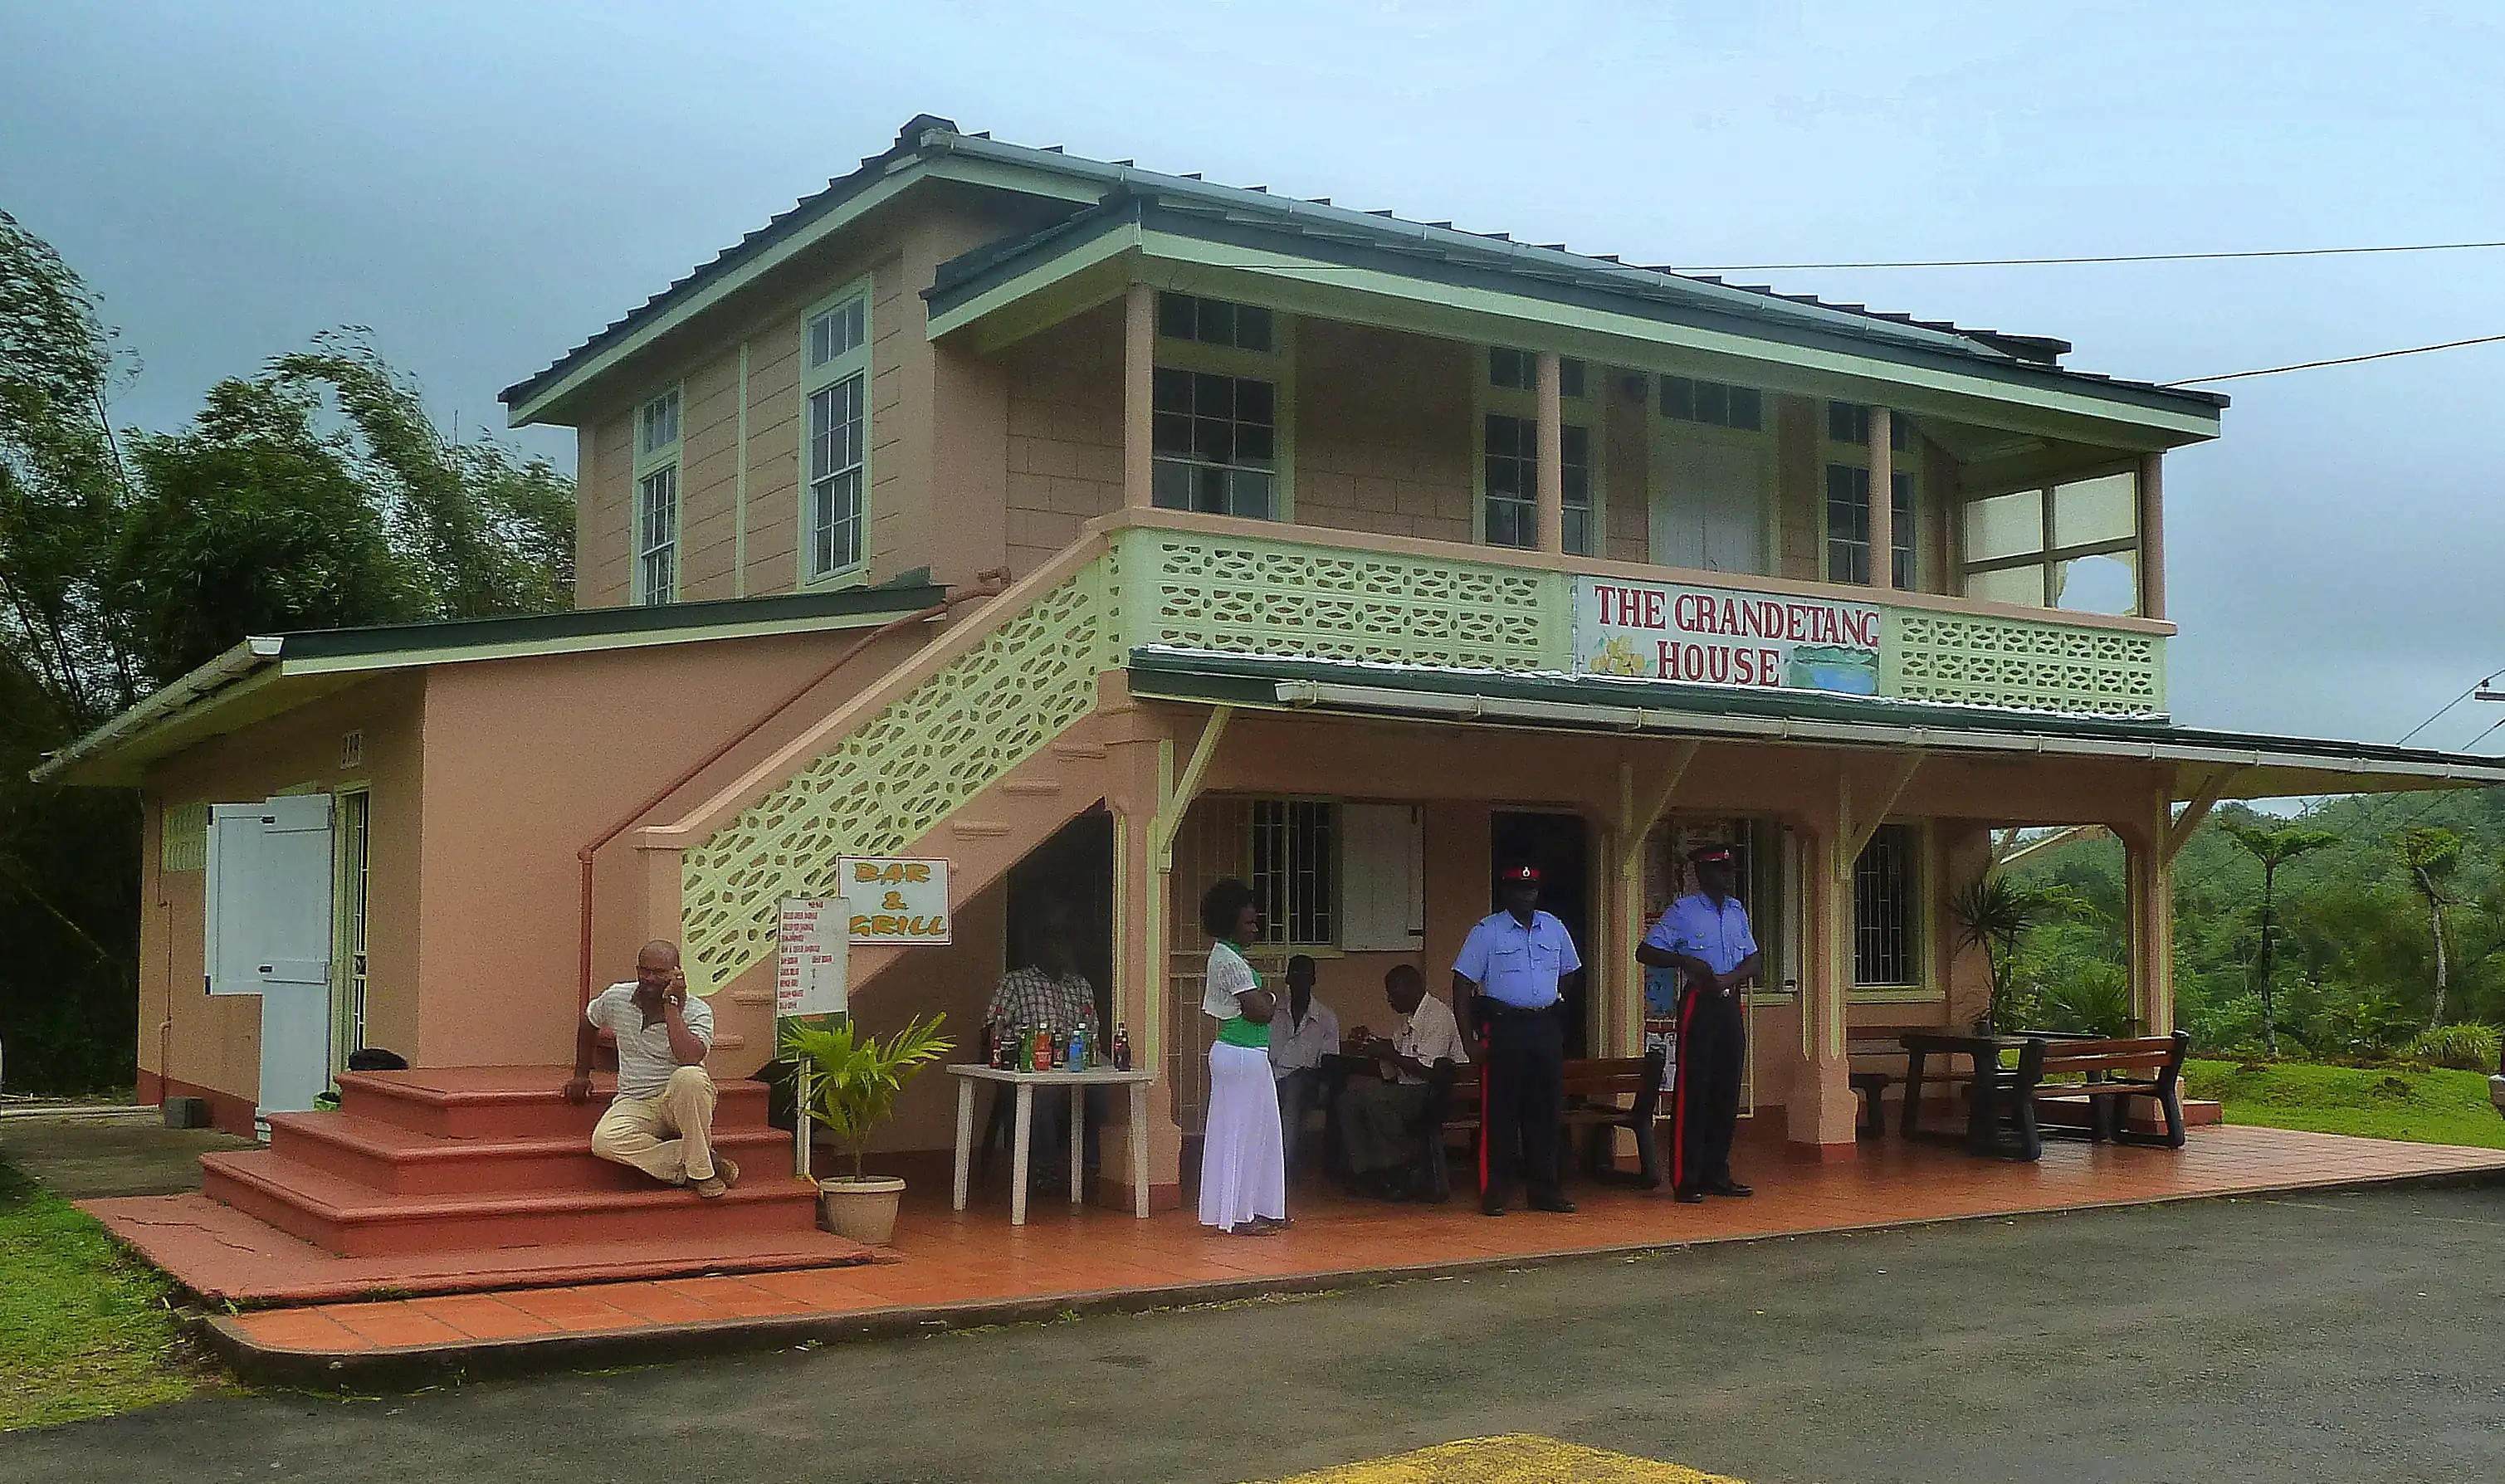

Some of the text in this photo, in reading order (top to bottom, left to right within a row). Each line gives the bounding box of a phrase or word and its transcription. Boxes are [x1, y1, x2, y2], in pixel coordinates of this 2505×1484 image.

[1594, 585, 1879, 647] THE GRANDETANG
[1658, 640, 1780, 686] HOUSE
[854, 862, 930, 885] BAR
[881, 891, 909, 910] &
[849, 915, 946, 936] GRILL
